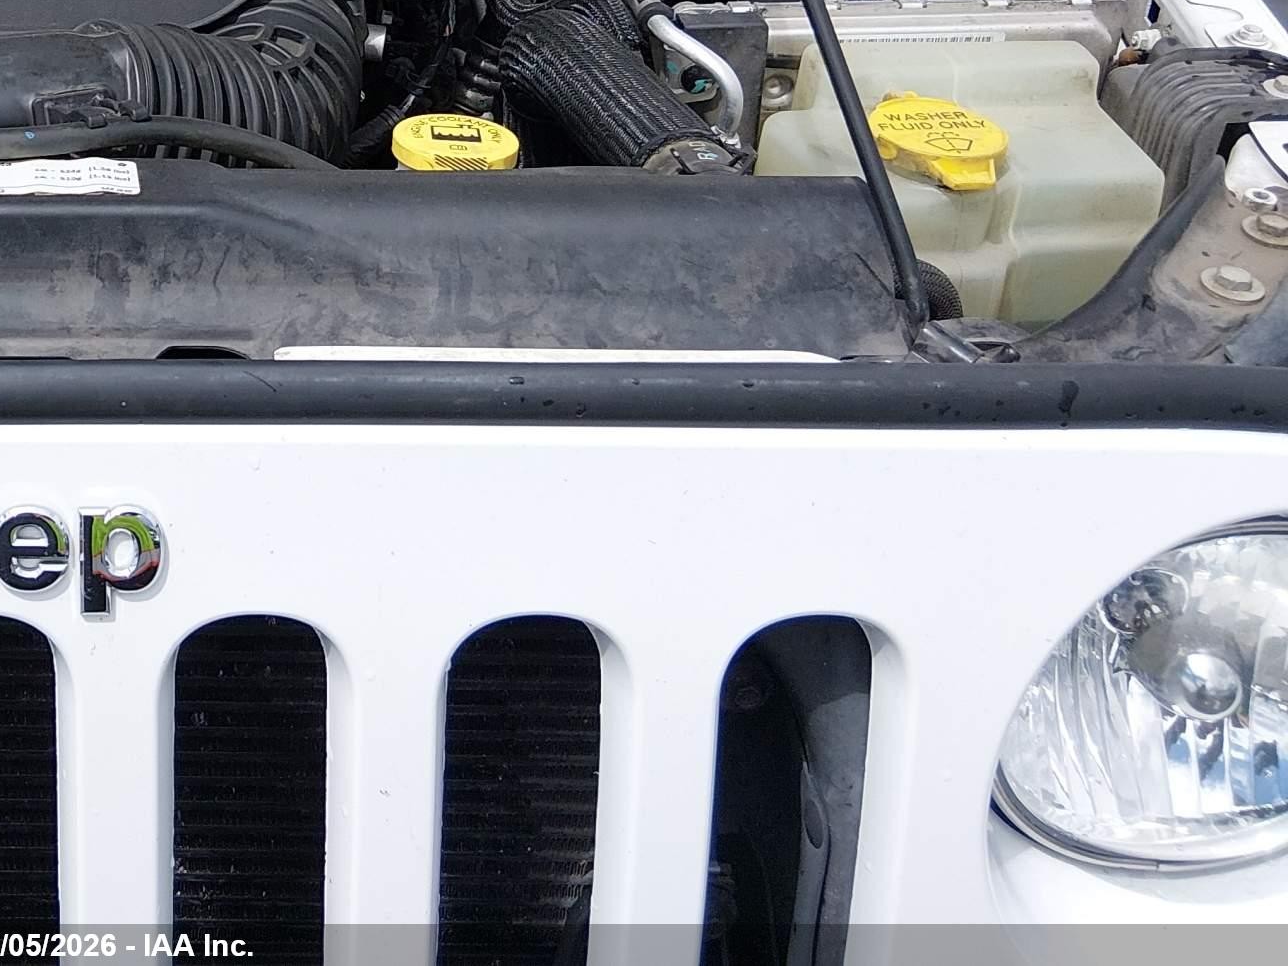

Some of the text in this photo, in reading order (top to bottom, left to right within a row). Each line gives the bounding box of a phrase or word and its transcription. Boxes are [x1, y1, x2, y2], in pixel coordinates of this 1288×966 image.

[428, 116, 493, 128] COOLANT
[883, 111, 968, 122] WASHER
[878, 119, 986, 131] FLUID ONLY
